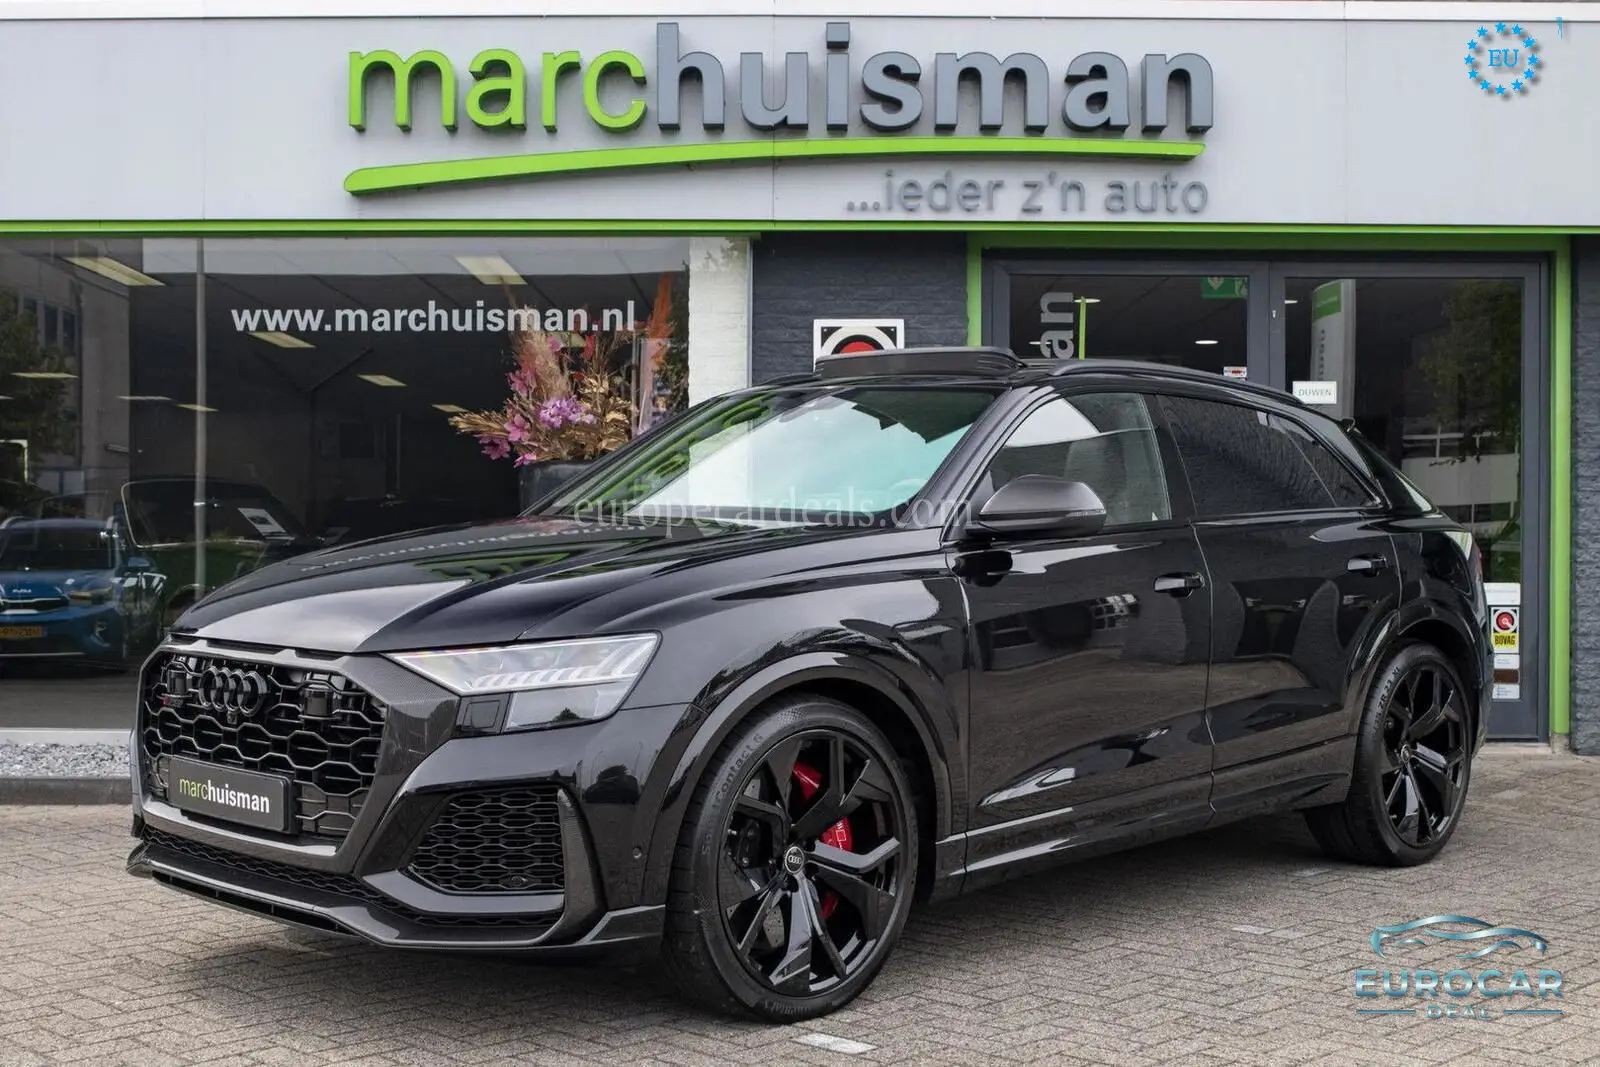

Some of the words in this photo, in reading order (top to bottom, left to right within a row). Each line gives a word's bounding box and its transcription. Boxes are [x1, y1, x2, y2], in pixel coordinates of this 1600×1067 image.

[347, 22, 1215, 134] marchuisman
[1021, 171, 1087, 213] z'n
[1104, 170, 1209, 213] auto
[231, 300, 636, 332] www.marchuisman.nl
[1298, 388, 1332, 397] DUWEN
[1494, 634, 1516, 646] BOVAG
[179, 776, 270, 814] marchuisman
